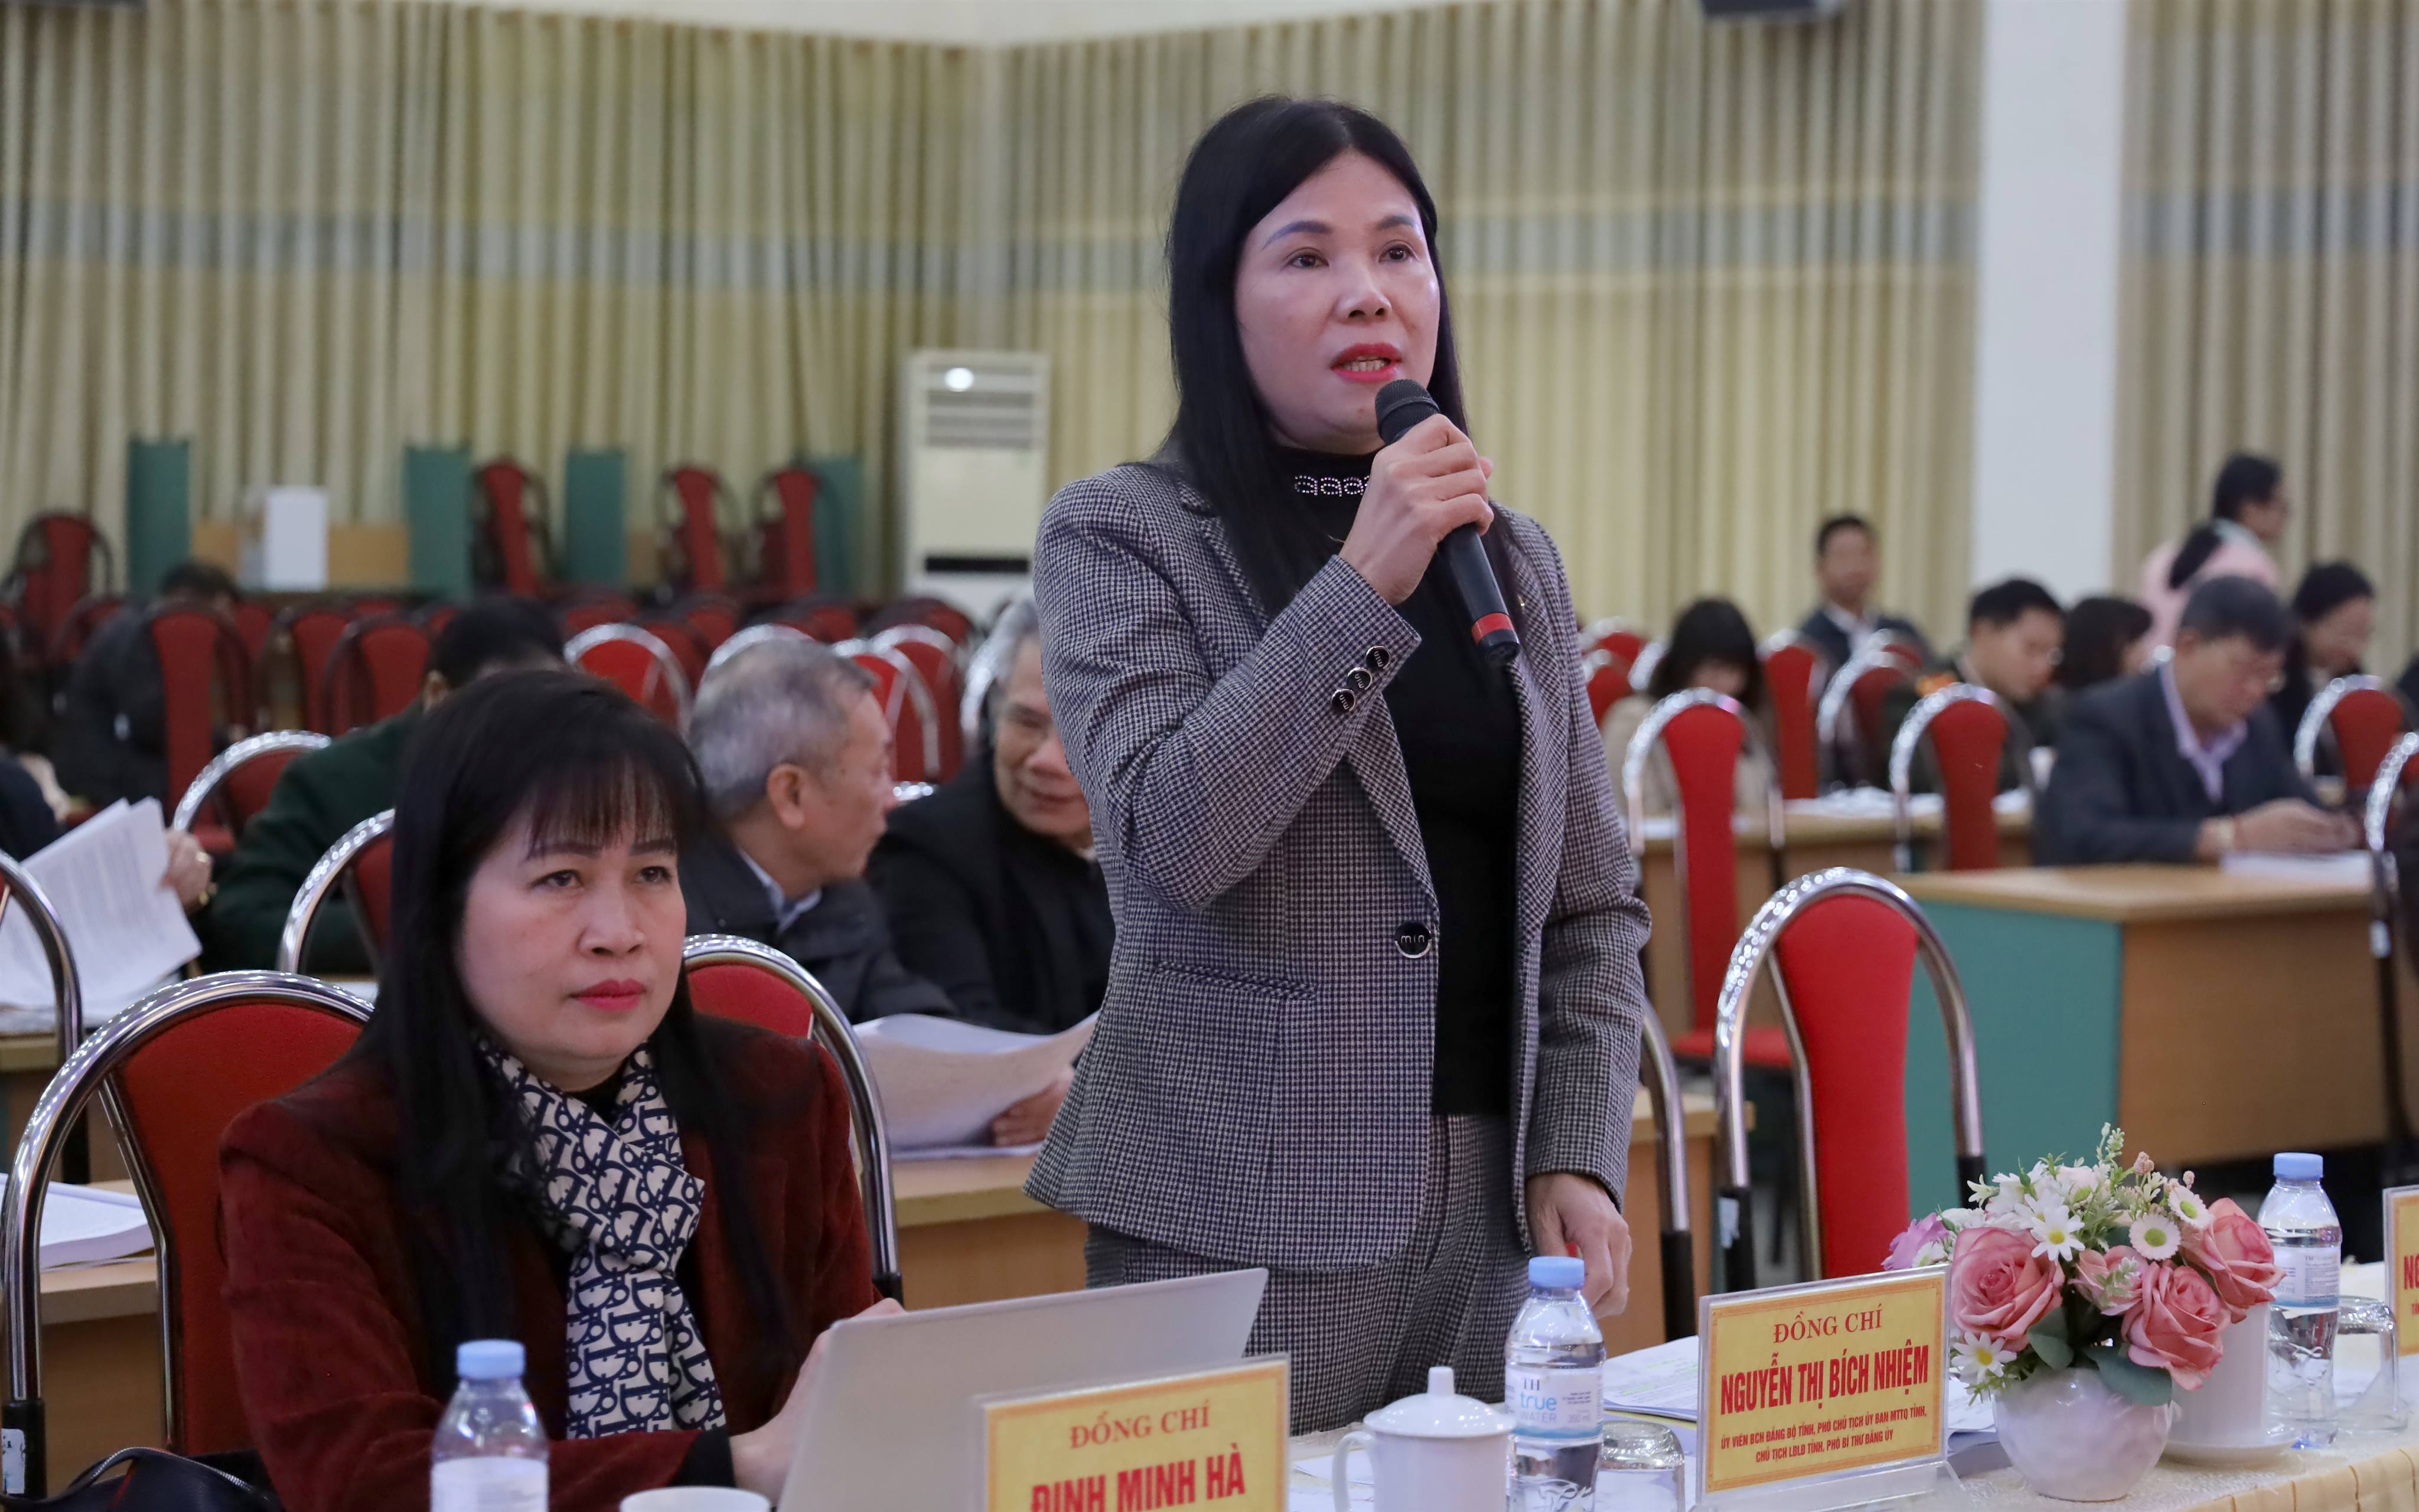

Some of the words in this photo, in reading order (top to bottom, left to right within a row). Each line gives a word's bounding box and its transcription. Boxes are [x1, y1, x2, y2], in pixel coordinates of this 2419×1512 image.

[1774, 1311, 1838, 1343] ĐỒNG
[1845, 1303, 1882, 1333] CHÍ
[1721, 1351, 1792, 1415] NGUYỄN
[1798, 1360, 1824, 1409] THỊ
[1829, 1348, 1869, 1398] BÍCH
[1874, 1339, 1928, 1395] NHIỆM
[1160, 1399, 1210, 1433] CHÍ
[1520, 1392, 1557, 1410] true
[1750, 1432, 1764, 1444] BCH
[1875, 1410, 1889, 1424] BAN
[1890, 1408, 1908, 1422] MTTQ
[1117, 1459, 1195, 1512] MINH
